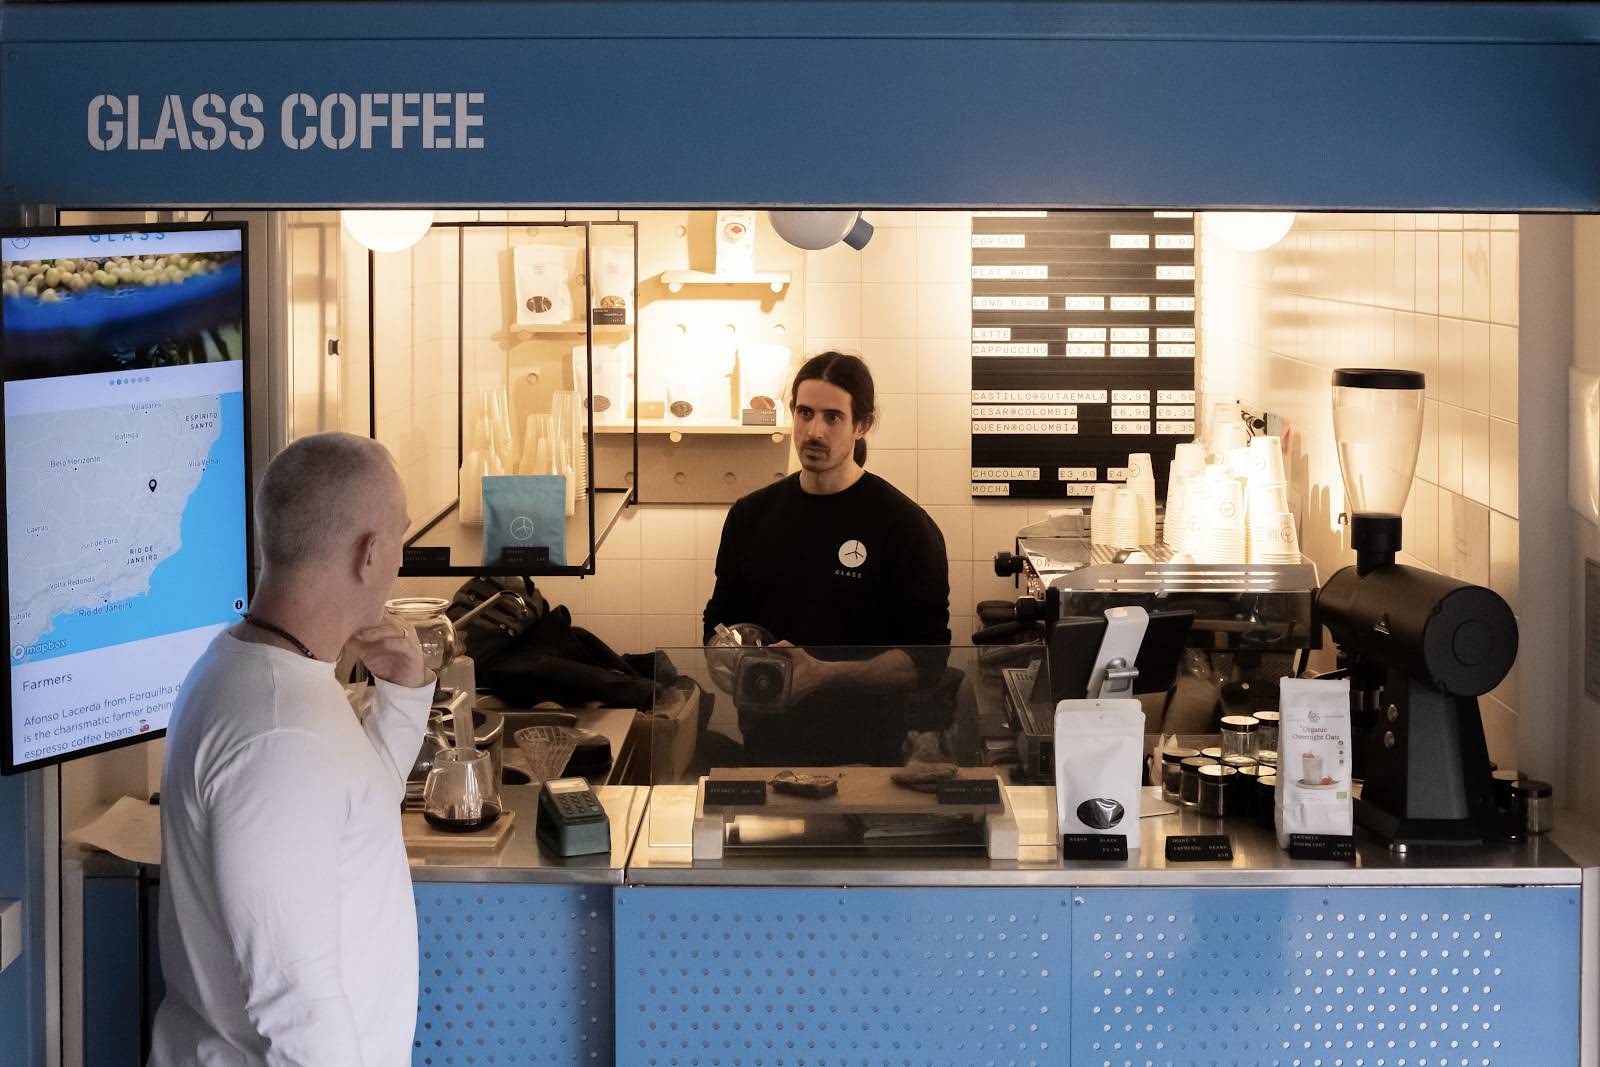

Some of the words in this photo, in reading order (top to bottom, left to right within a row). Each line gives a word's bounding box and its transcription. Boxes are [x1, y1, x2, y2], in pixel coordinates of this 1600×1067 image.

[87, 92, 265, 151] GLASS
[281, 92, 485, 150] COFFEE
[972, 329, 1010, 339] LATTE
[972, 345, 1047, 355] CAPPUCCINO
[190, 421, 213, 431] SANTO
[972, 470, 1039, 478] CHOCOLATE
[972, 485, 1009, 493] MOCHA
[129, 547, 143, 555] RIO
[126, 554, 158, 566] JANEIRO
[834, 568, 863, 579] GLASS
[78, 609, 92, 618] Rio
[93, 607, 103, 616] de
[104, 601, 134, 614] Janeiro
[26, 640, 67, 655] mapbox
[22, 672, 73, 692] Farmers
[23, 712, 59, 728] Afonso
[62, 703, 101, 719] Lacerda
[104, 695, 127, 709] from
[129, 684, 173, 704] Forquilha
[23, 735, 32, 744] is
[34, 729, 51, 742] the
[53, 715, 110, 738] charismatic
[112, 707, 144, 723] farmer
[146, 700, 175, 715] behin
[1302, 726, 1328, 734] Organic
[24, 741, 69, 760] espresso
[71, 733, 102, 749] coffee
